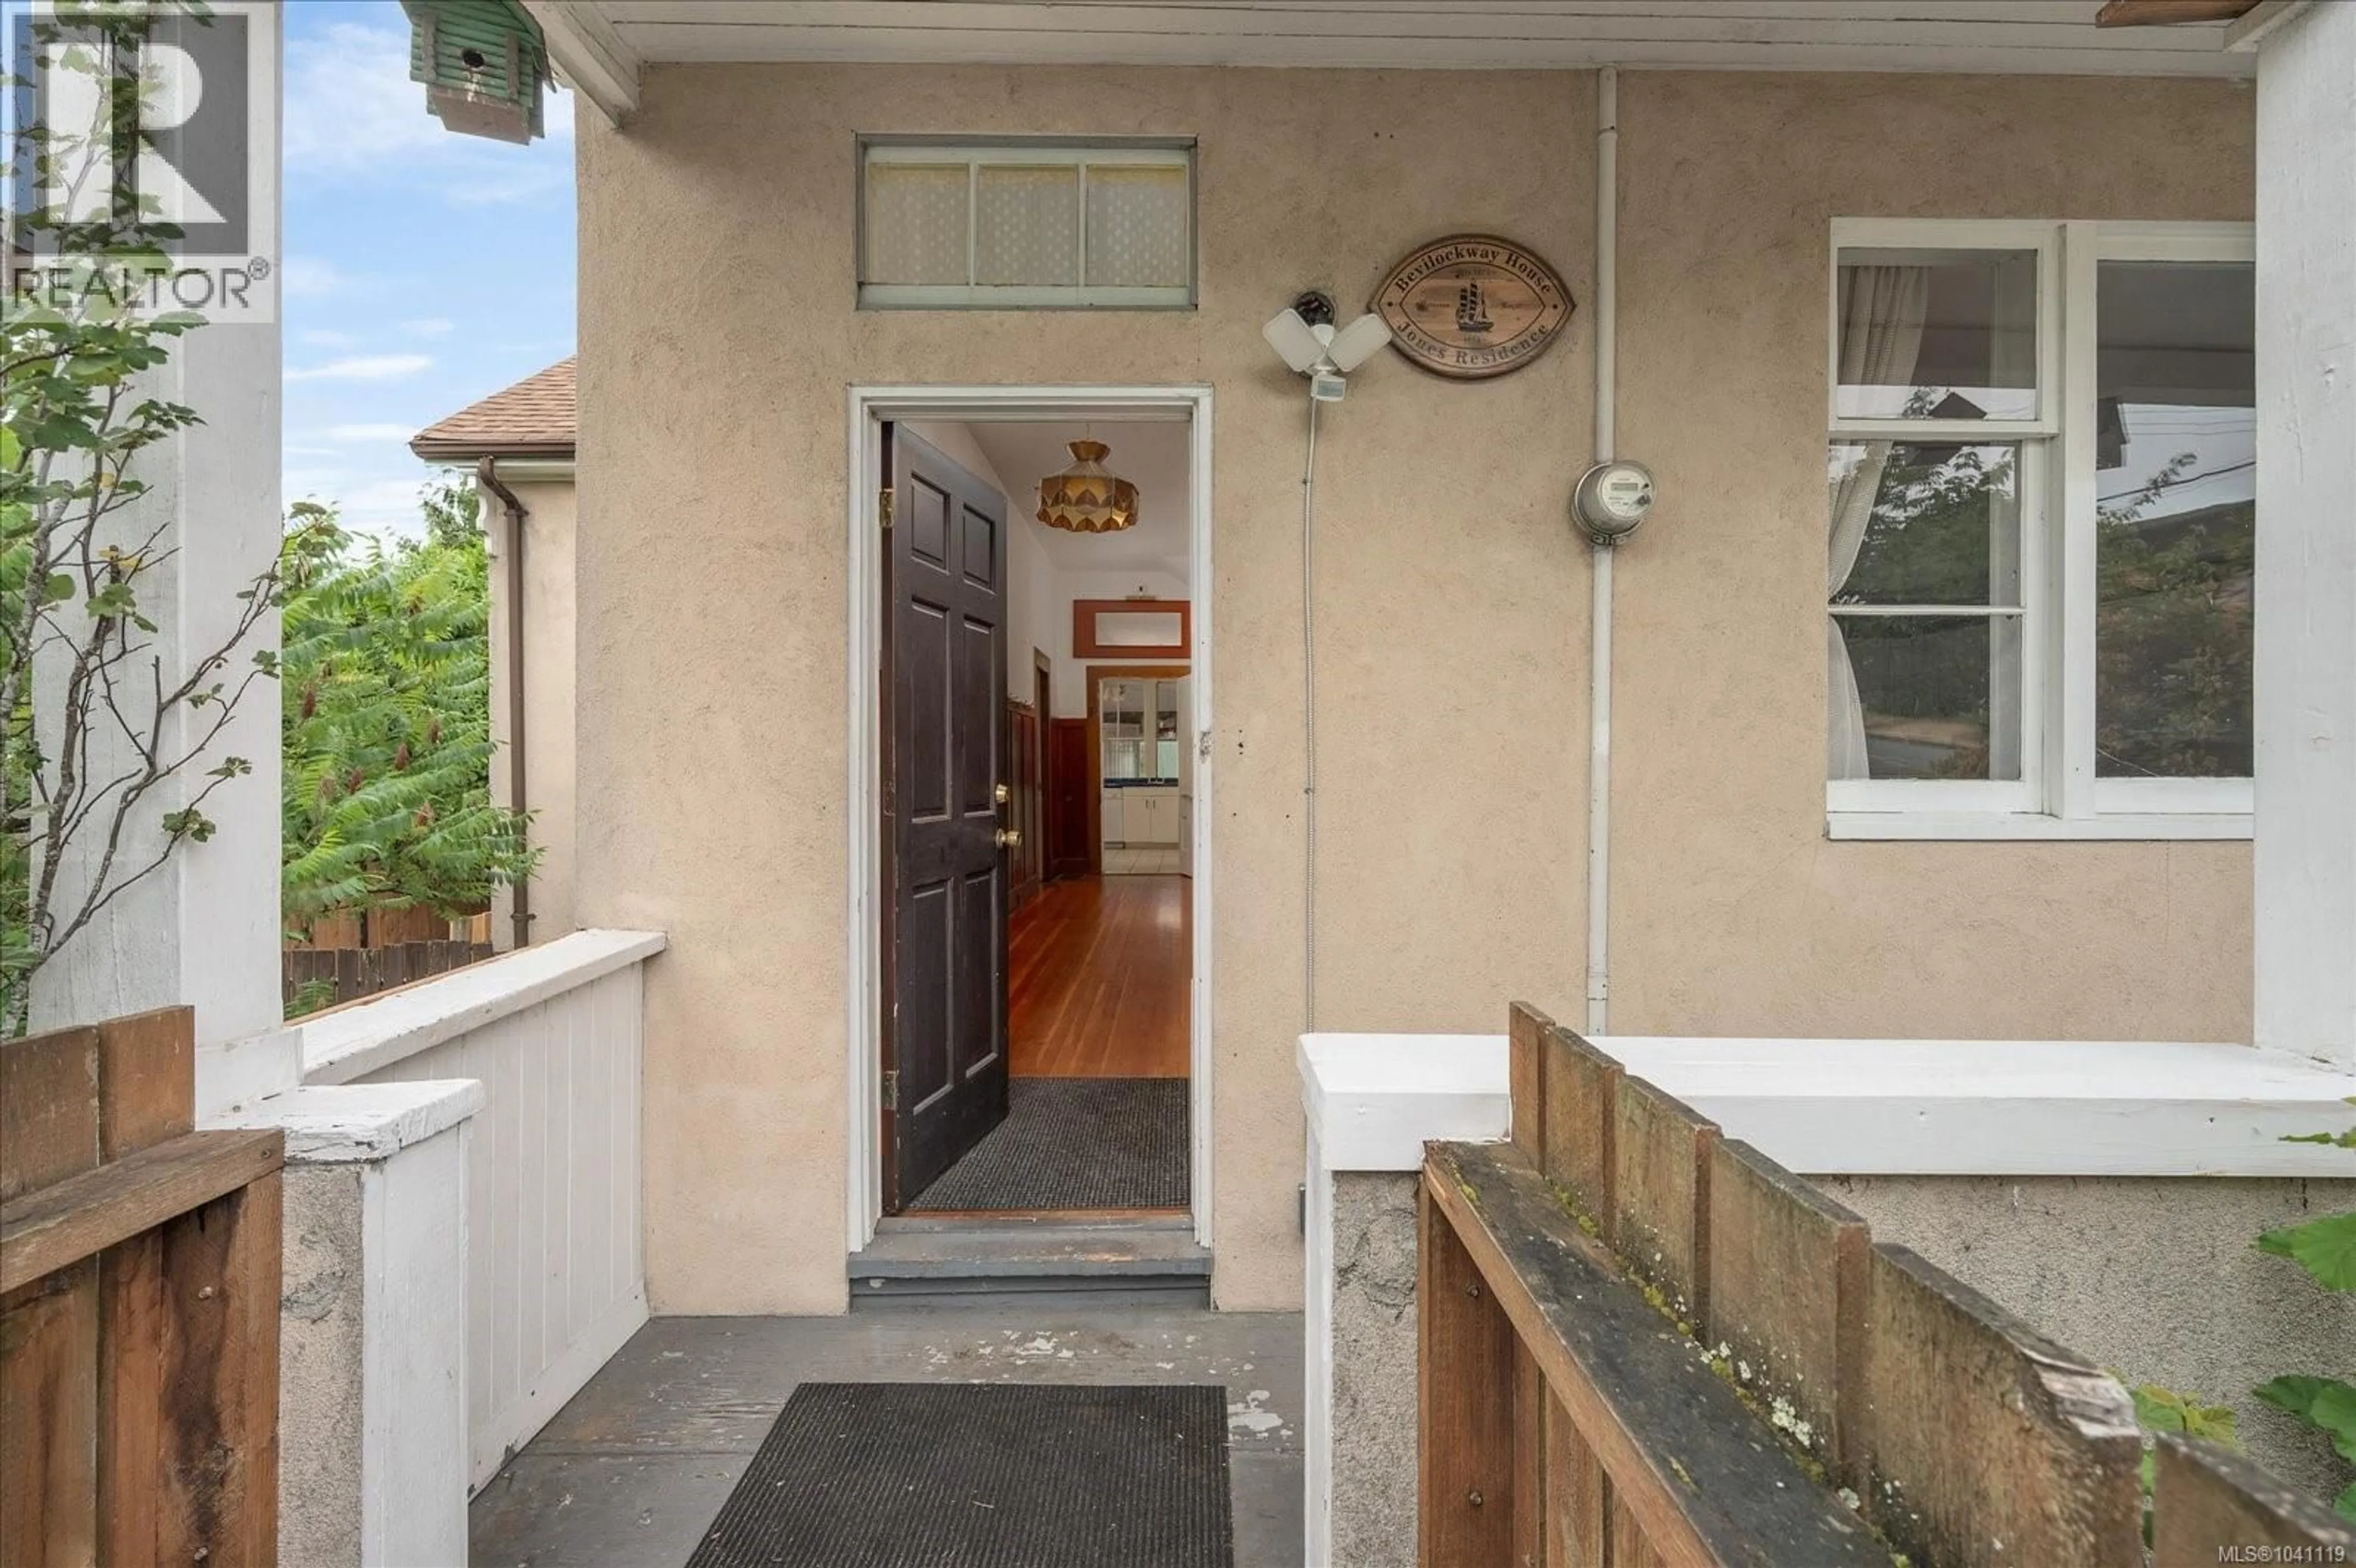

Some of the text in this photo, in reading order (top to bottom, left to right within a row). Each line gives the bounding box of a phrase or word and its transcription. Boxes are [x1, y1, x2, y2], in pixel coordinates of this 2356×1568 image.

[1395, 246, 1551, 294] Bevilockway House
[1397, 321, 1549, 365] Jones Residence
